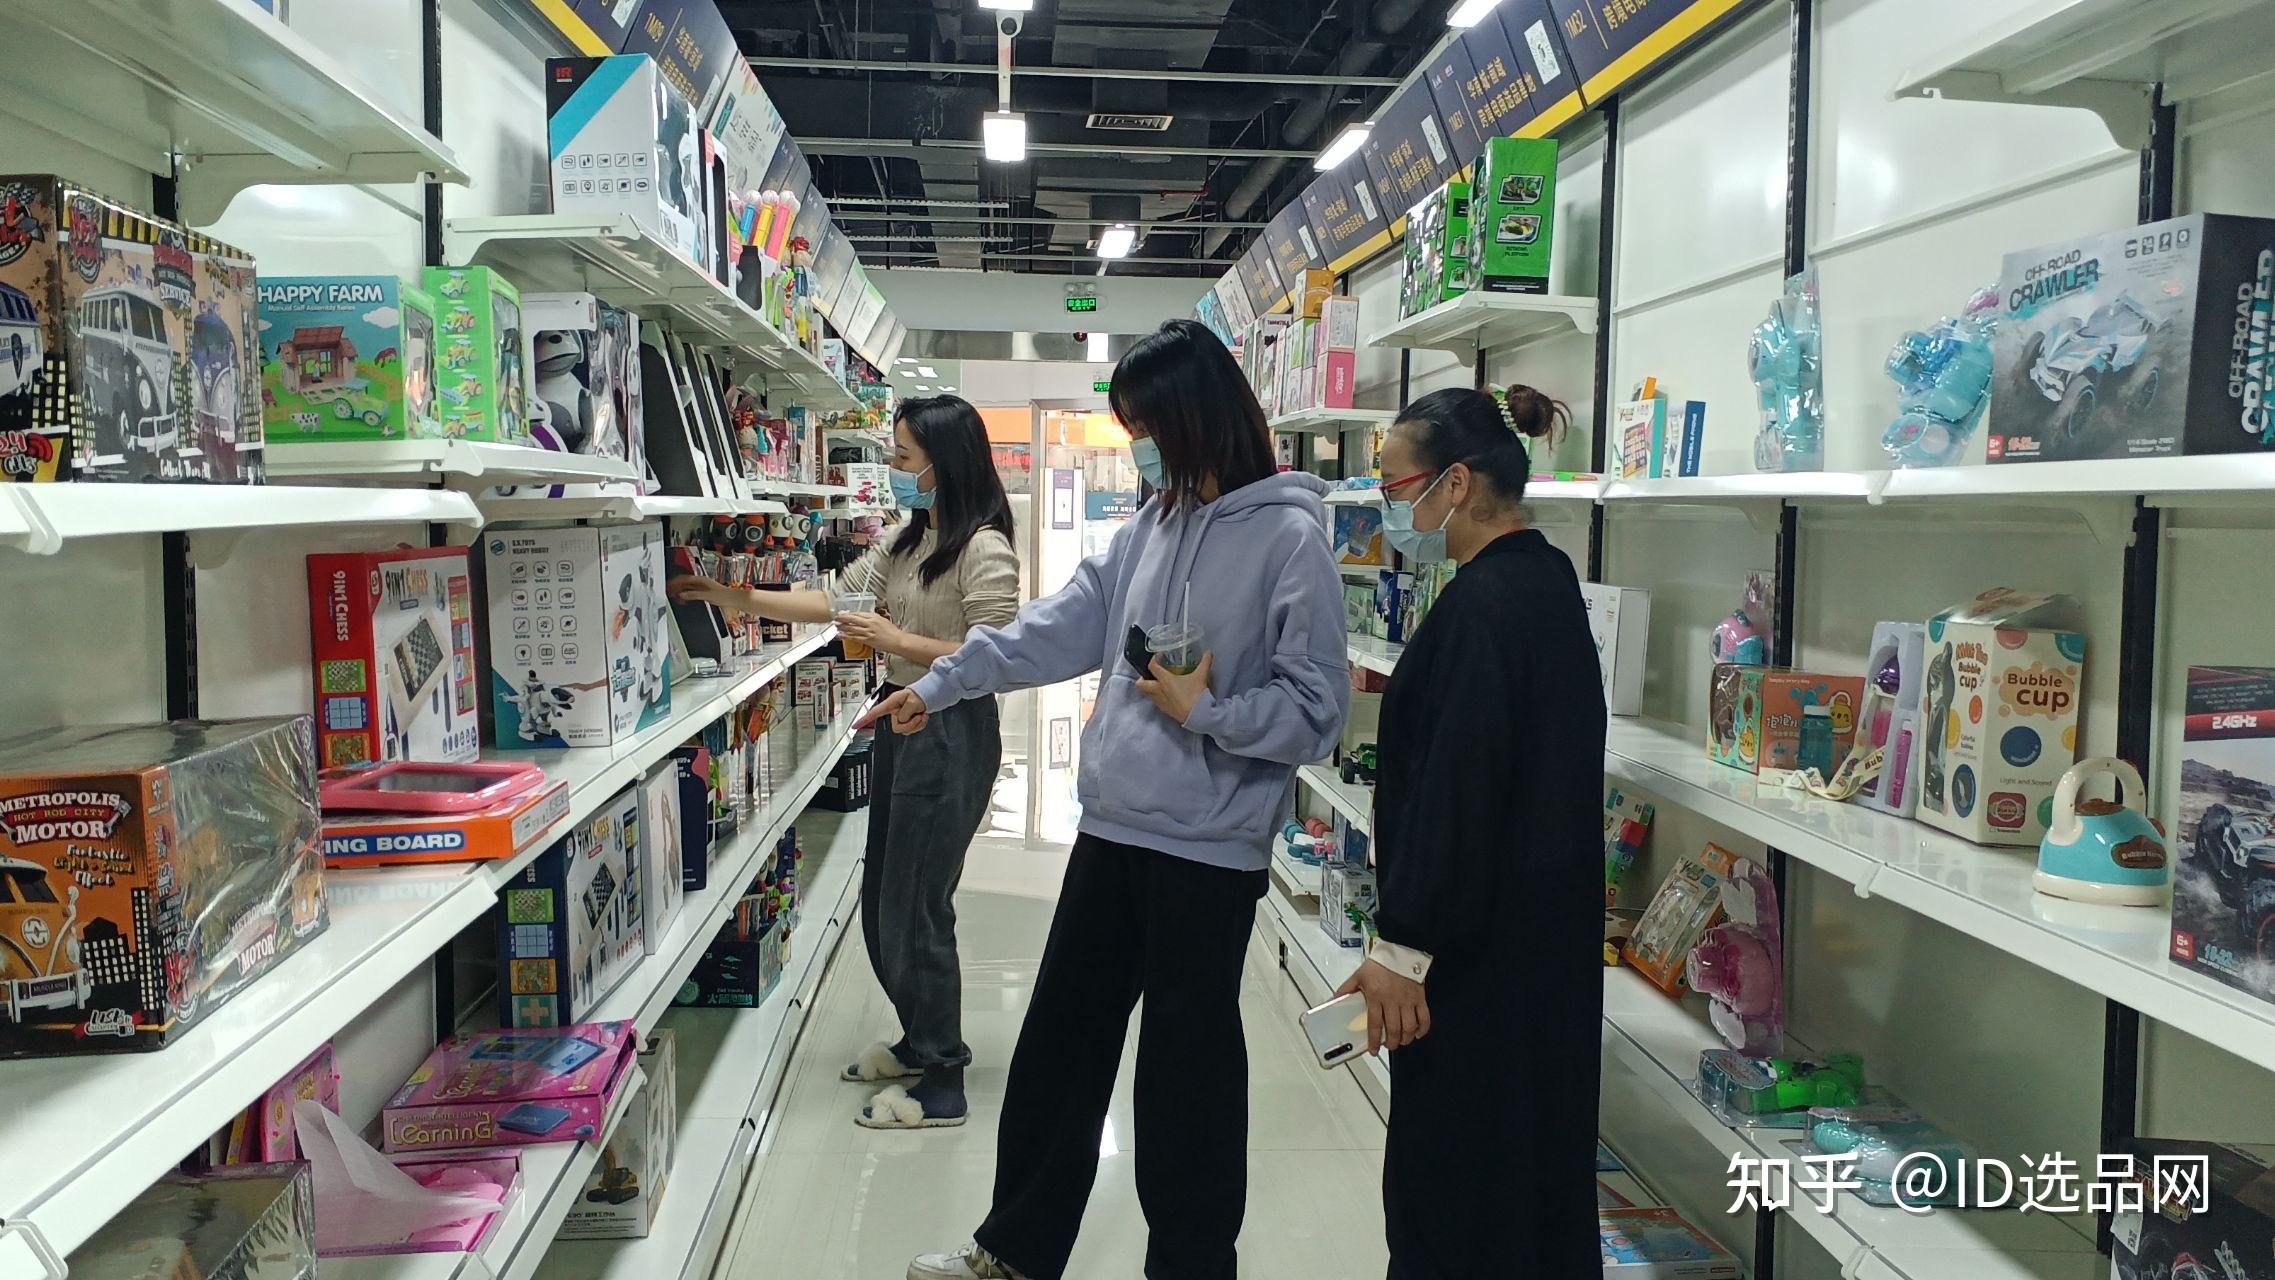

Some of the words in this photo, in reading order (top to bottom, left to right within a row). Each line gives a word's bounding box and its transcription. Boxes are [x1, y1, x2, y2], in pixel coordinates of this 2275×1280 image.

[1565, 10, 1587, 39] 1M32
[257, 285, 323, 303] HAPPY
[329, 284, 383, 303] FARM
[2009, 258, 2100, 312] CRAWLER
[333, 570, 348, 601] 9IN1
[335, 603, 349, 642] CHESS
[1958, 662, 1981, 675] Bubble
[1959, 675, 1978, 692] cup
[2008, 673, 2063, 688] Bubble
[2016, 689, 2070, 712] cup
[2000, 778, 2016, 786] Light
[0, 791, 120, 814] METROPOLIS
[13, 811, 37, 822] HOT
[44, 809, 67, 818] ROD
[74, 808, 105, 816] CITY
[15, 820, 107, 844] MOTOR
[376, 833, 462, 851] BOARD
[240, 932, 276, 972] MOTOR
